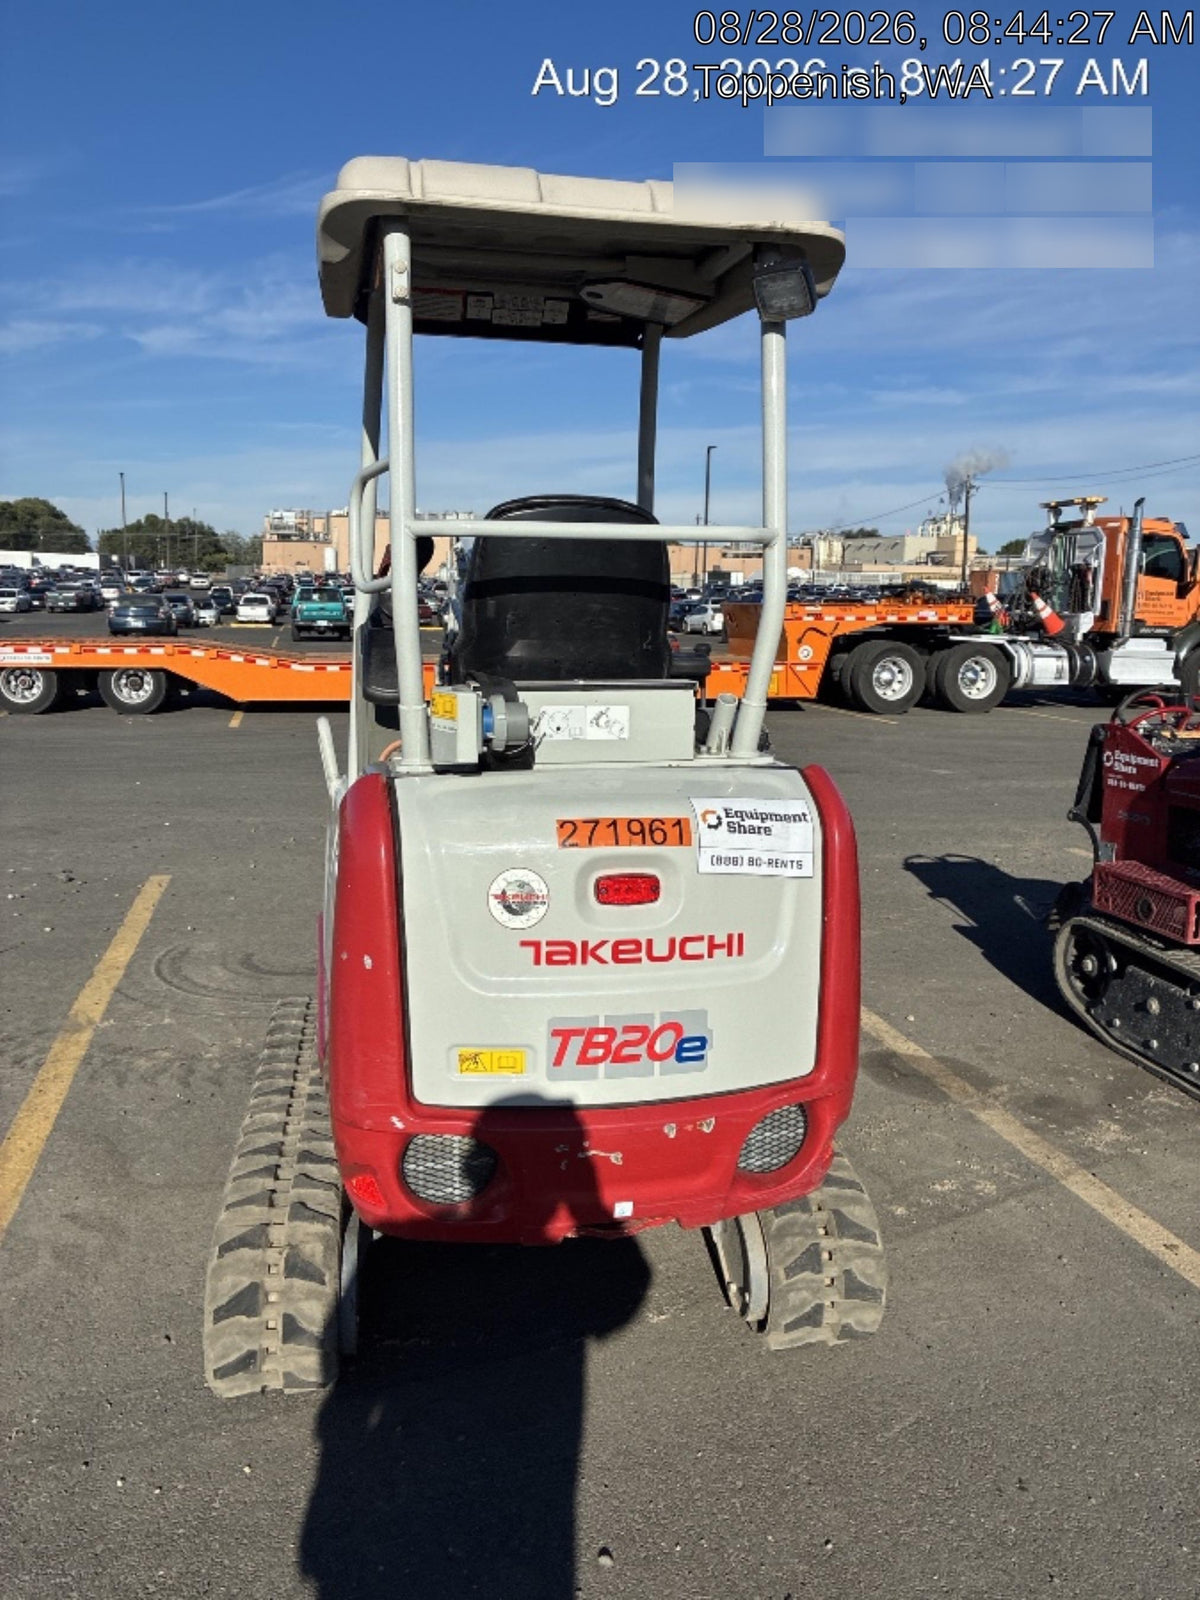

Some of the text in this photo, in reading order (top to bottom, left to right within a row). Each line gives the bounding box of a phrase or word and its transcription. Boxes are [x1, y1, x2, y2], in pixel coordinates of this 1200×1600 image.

[722, 806, 809, 824] Equipment
[559, 818, 683, 847] 271961
[726, 820, 773, 837] Share
[550, 1021, 708, 1068] TB20e
